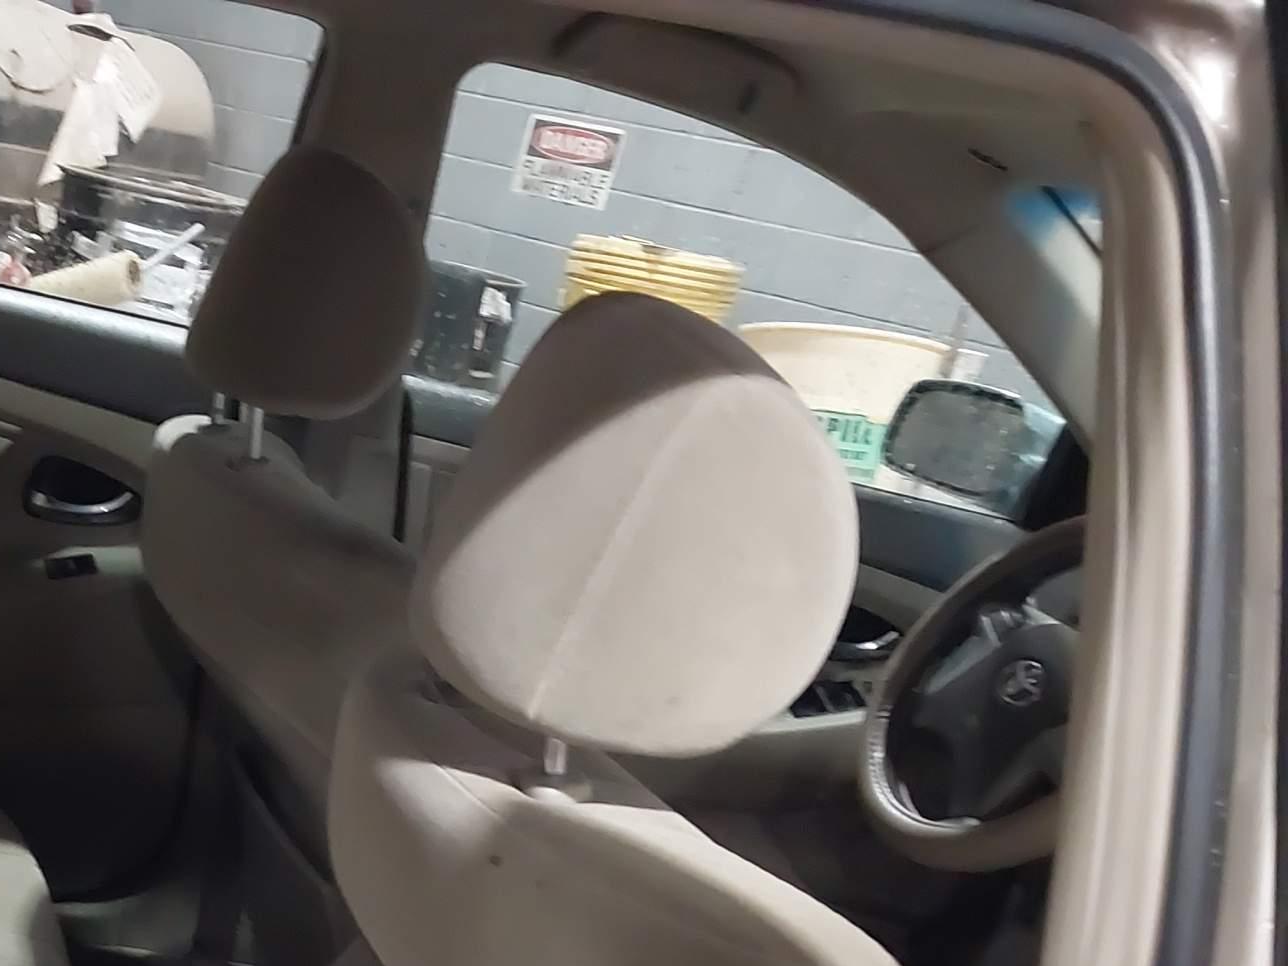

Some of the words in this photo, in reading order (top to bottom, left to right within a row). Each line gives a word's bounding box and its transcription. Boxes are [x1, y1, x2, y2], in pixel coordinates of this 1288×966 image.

[537, 130, 610, 161] DANGER
[521, 158, 610, 190] FLAMMABLE
[815, 415, 873, 445] PILL
